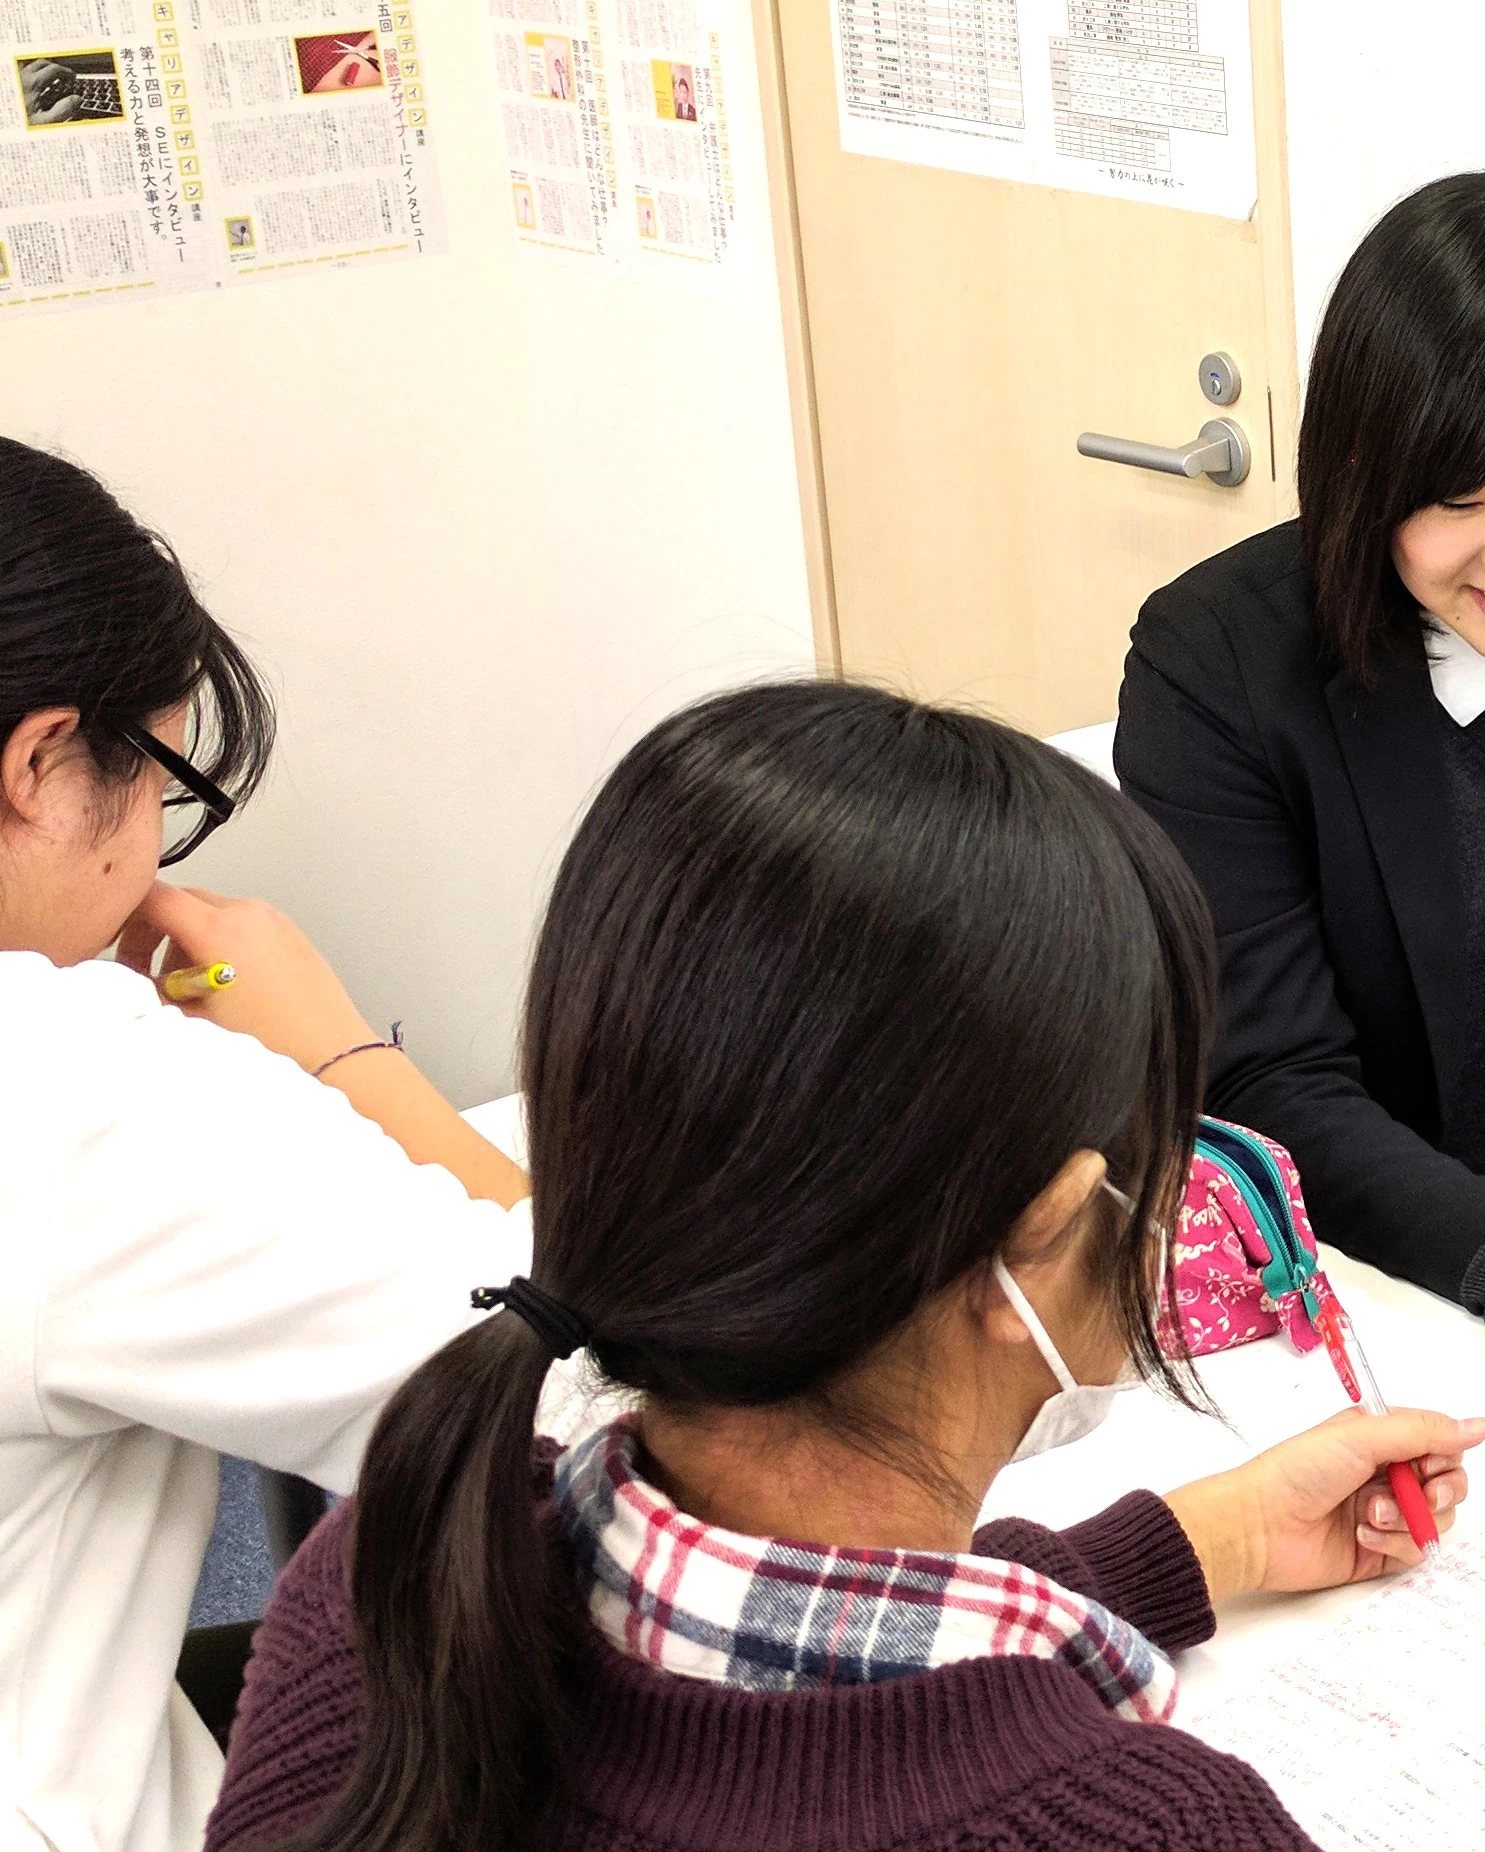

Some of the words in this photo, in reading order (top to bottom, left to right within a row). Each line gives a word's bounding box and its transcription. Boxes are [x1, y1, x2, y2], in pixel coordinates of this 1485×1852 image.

[376, 0, 393, 32] 五回
[120, 47, 165, 240] 考える力と発想が大事です。
[139, 46, 162, 108] 第十四回
[155, 126, 187, 263] SEにインタビュー
